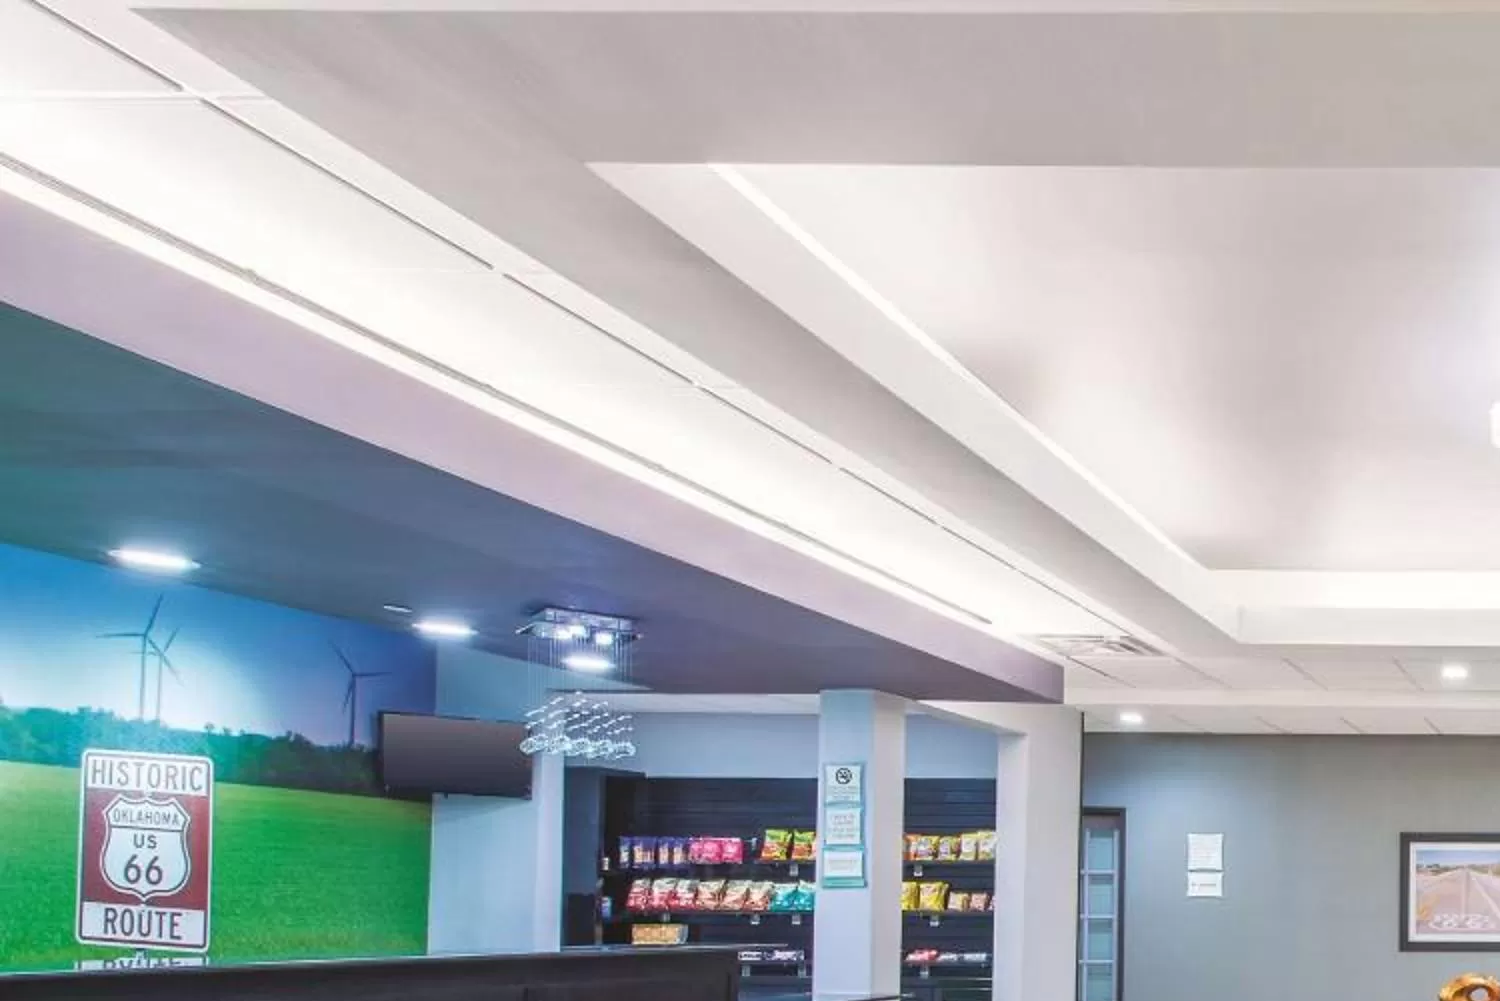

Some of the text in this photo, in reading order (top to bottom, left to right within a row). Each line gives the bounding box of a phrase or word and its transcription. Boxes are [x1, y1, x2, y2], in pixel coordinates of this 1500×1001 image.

[91, 759, 203, 792] HISTORIC
[112, 808, 180, 826] OKLAHOMA
[133, 833, 158, 849] US
[124, 854, 163, 886] 66
[103, 906, 183, 940] ROUTE
